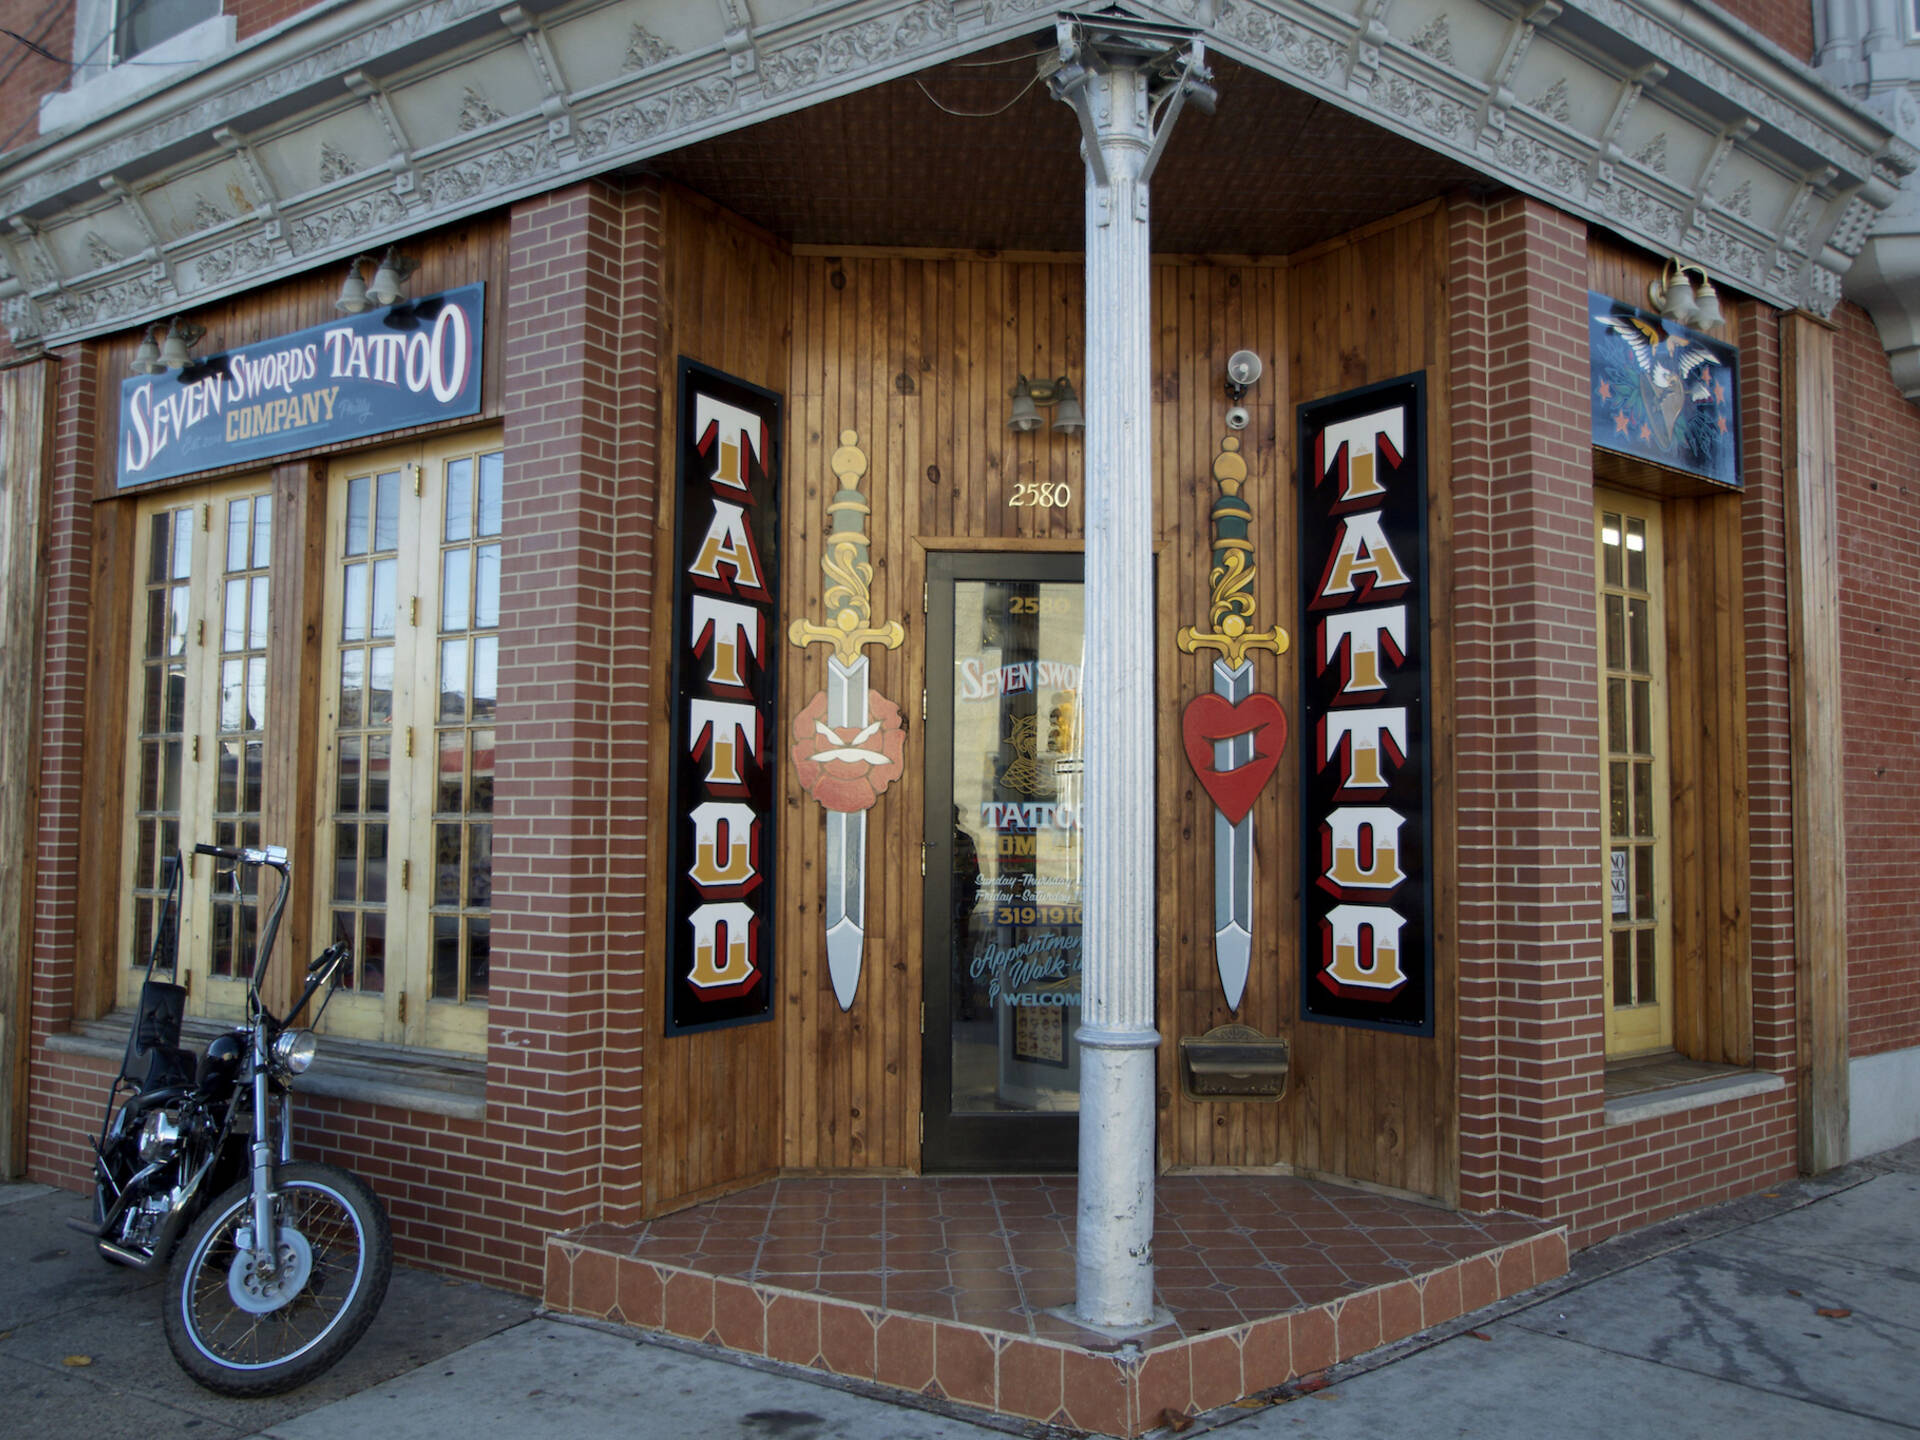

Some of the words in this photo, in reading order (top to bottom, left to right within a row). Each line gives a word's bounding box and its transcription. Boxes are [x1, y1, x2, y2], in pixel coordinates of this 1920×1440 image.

[125, 371, 224, 473] SEVEN
[226, 343, 317, 404] SWORDS
[324, 303, 471, 404] TATTOO
[225, 386, 340, 443] COMPANY
[1008, 482, 1071, 508] 2580
[687, 392, 768, 996] TATTOO
[960, 656, 1035, 702] SEVEN
[1313, 405, 1411, 996] TATTOO
[981, 801, 1083, 832] TATTO
[969, 931, 1083, 978] Appointmen
[1009, 952, 1082, 989] Walk-i
[1002, 992, 1082, 1007] WELCOM
